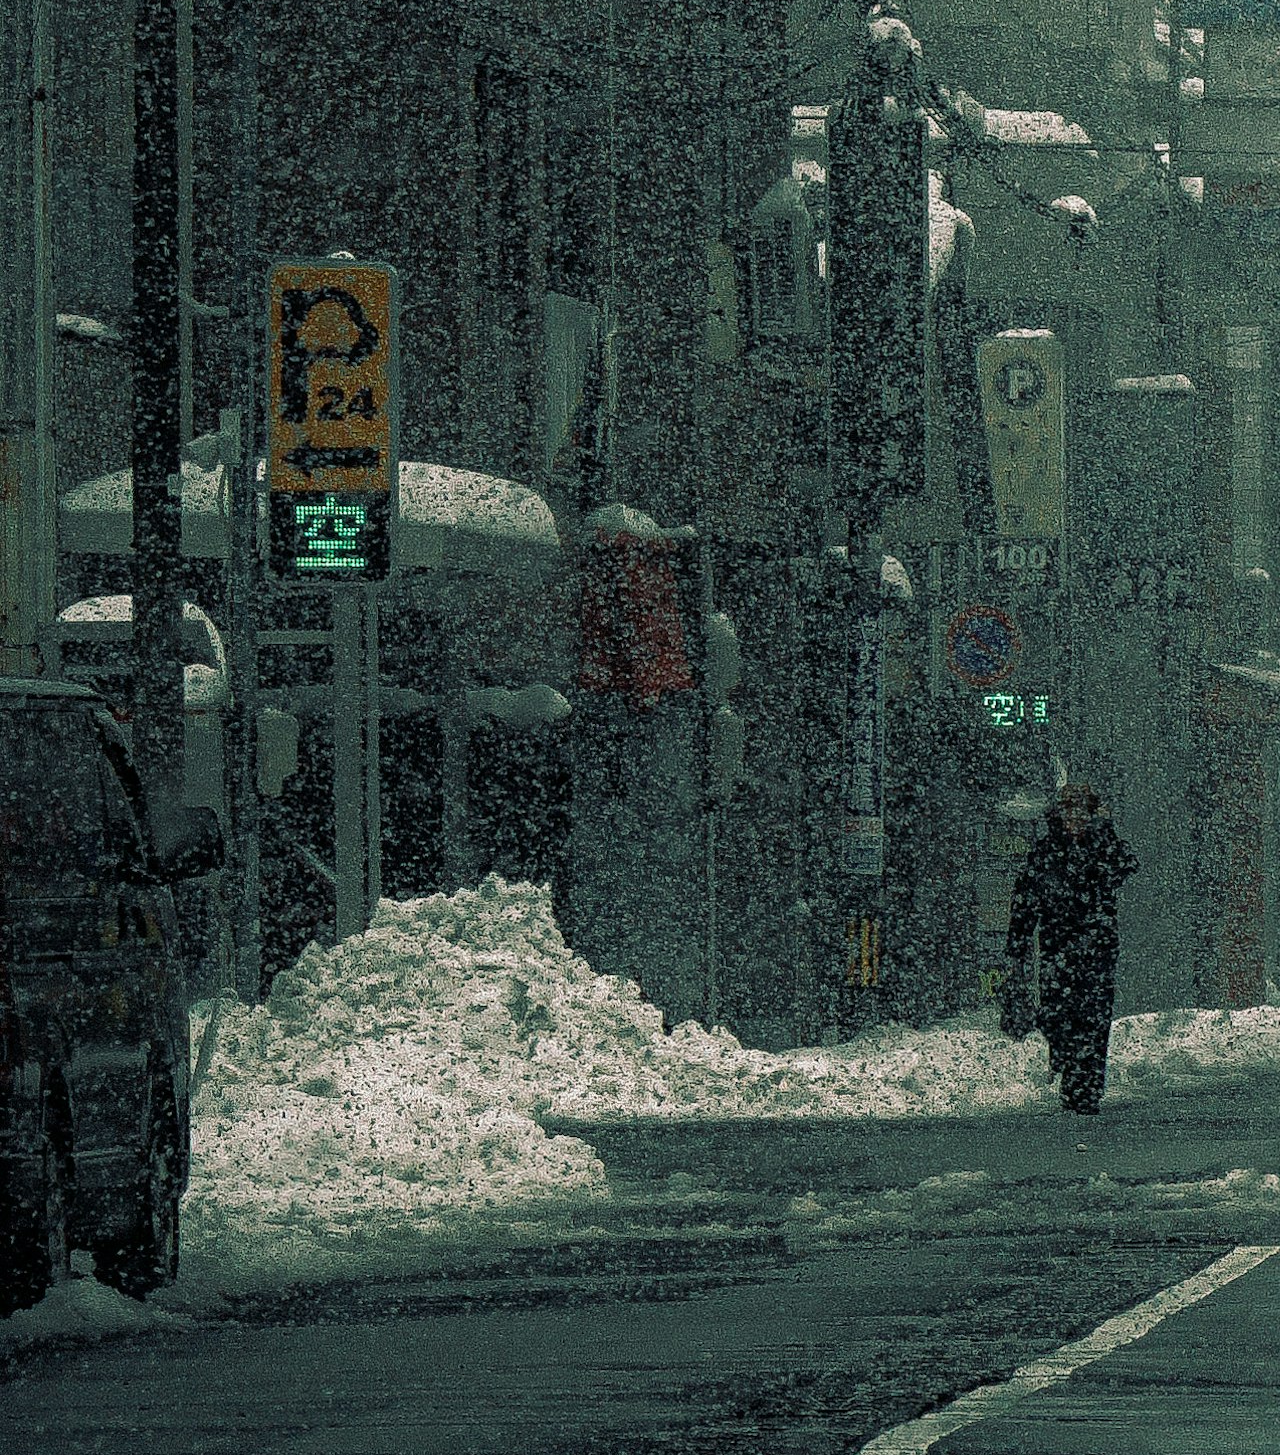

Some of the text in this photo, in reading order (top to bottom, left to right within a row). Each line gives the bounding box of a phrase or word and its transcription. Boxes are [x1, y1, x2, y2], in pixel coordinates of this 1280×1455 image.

[281, 288, 379, 423] P
[1008, 369, 1034, 401] P
[317, 386, 378, 422] 24
[295, 493, 367, 571] 空
[990, 547, 1048, 570] 100
